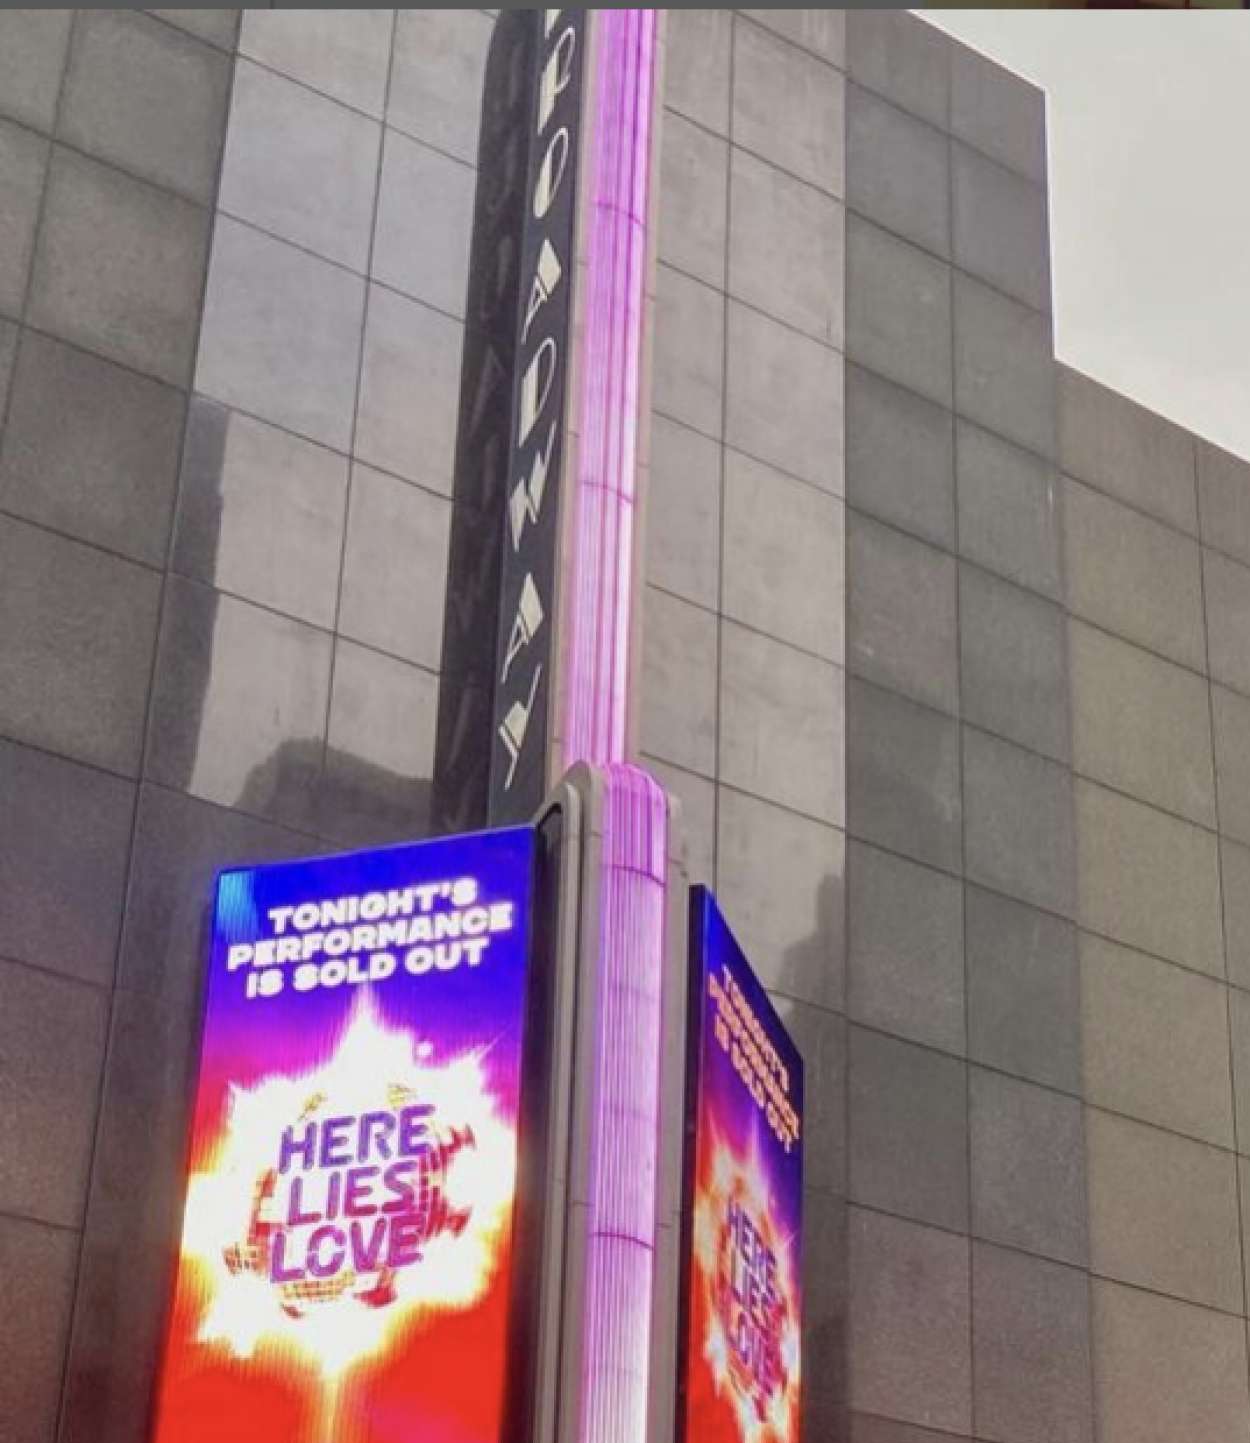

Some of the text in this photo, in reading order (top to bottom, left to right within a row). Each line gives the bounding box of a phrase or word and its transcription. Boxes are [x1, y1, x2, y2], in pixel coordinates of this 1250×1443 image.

[227, 901, 514, 970] PERFORMANCE
[268, 876, 478, 934] TONIGHT'S
[246, 936, 489, 998] IS SOLD OUT
[279, 1103, 435, 1174] HERE
[288, 1160, 419, 1225] LIES
[270, 1213, 424, 1284] LOVE
